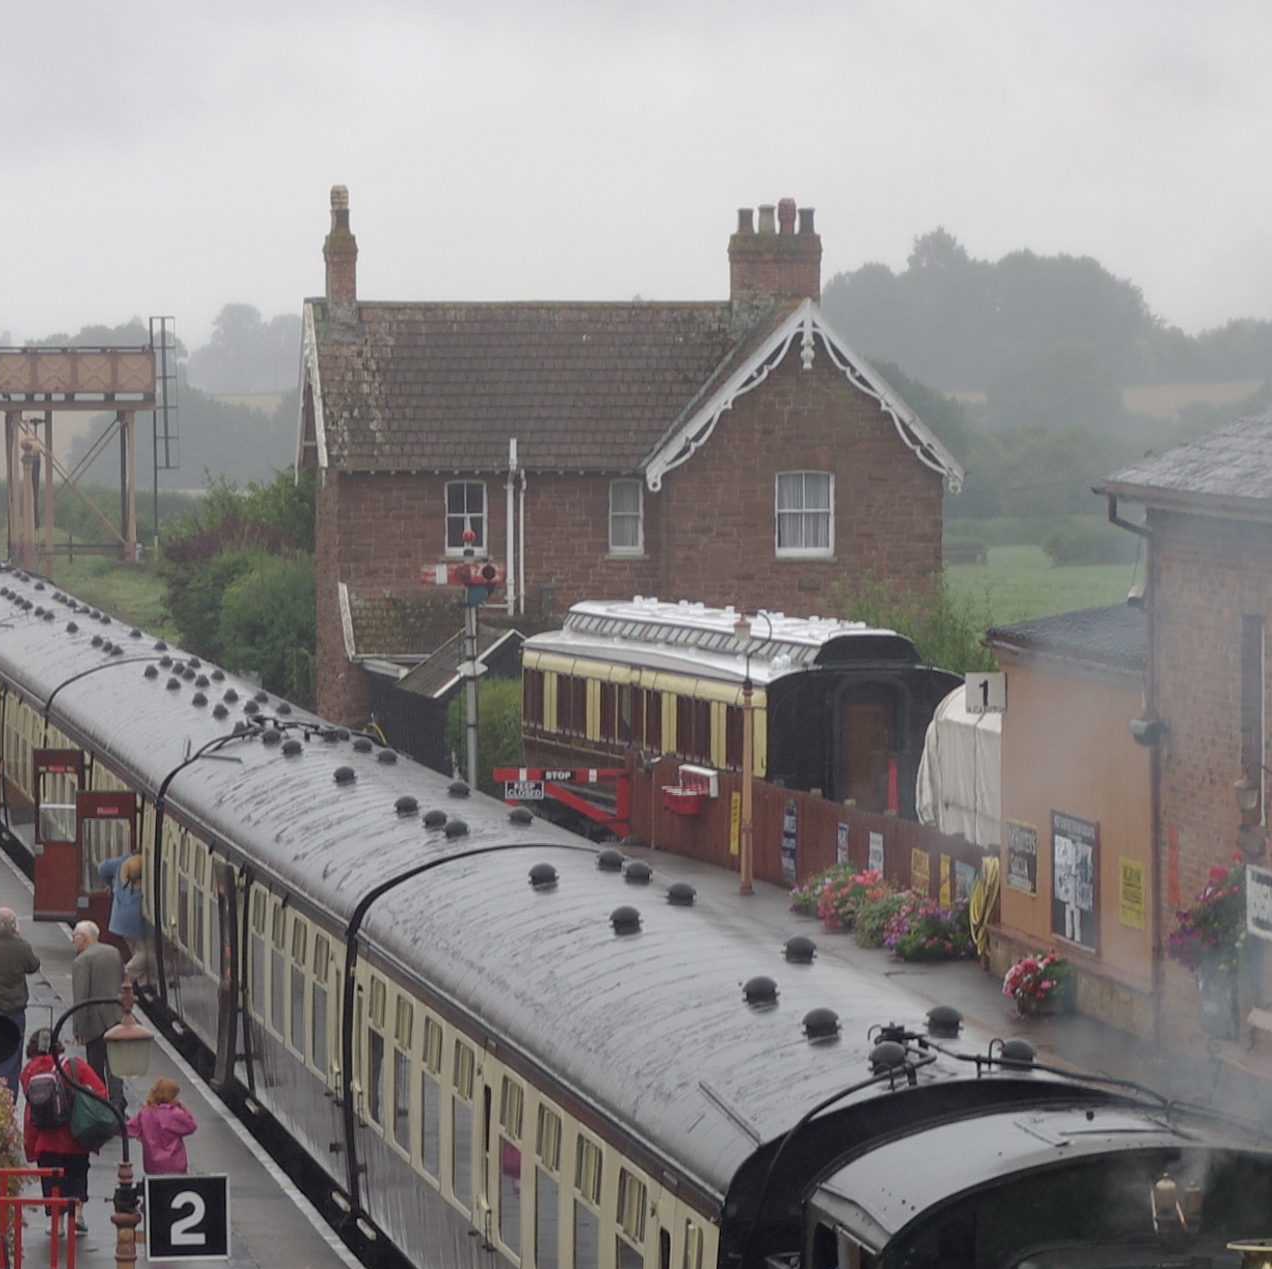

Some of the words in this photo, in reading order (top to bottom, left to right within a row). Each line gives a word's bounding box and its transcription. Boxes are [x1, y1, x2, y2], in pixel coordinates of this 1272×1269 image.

[978, 680, 989, 707] 1
[545, 771, 572, 780] STOP
[508, 788, 541, 798] CLOSED
[170, 1190, 207, 1247] 2
